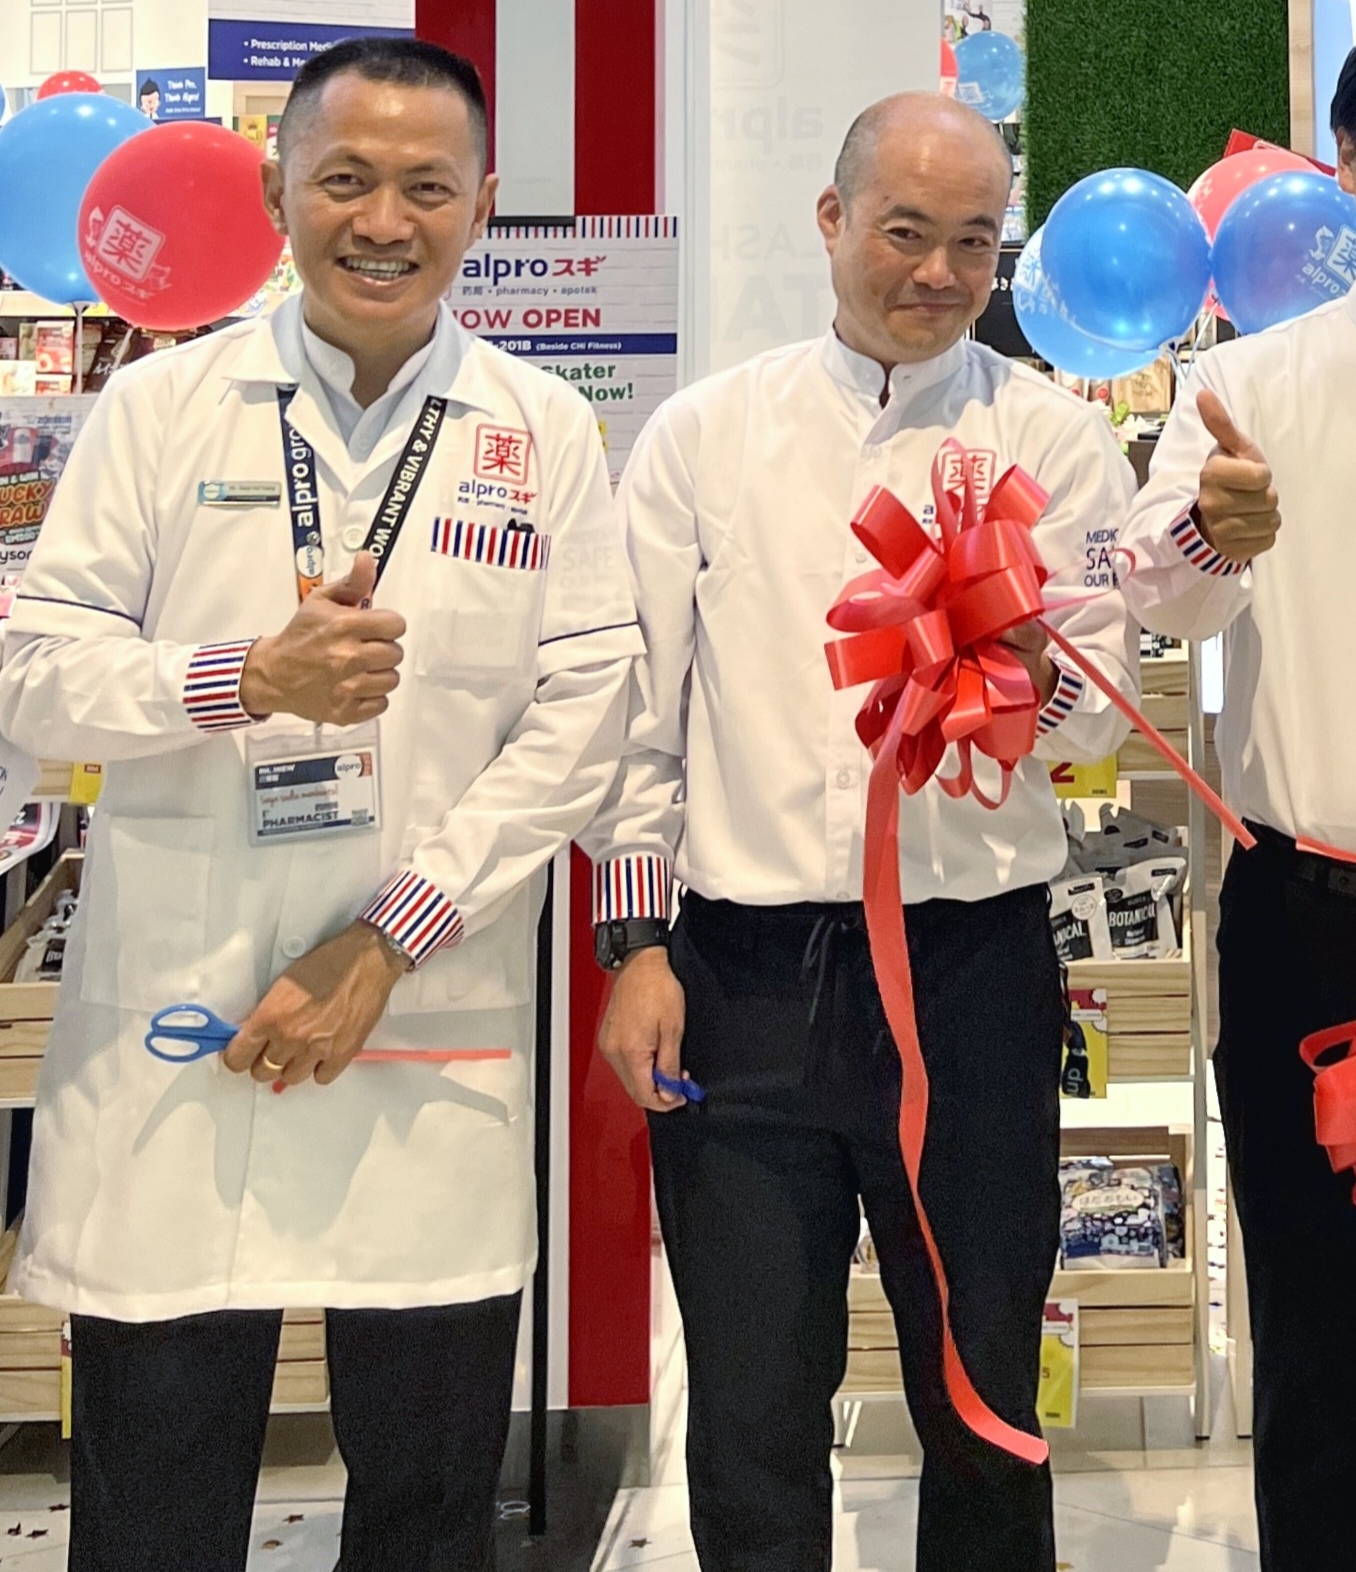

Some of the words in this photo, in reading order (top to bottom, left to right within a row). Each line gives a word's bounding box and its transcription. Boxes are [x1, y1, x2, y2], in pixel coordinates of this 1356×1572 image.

[251, 39, 307, 51] Prescription
[251, 57, 281, 67] Rehab
[283, 57, 290, 67] &
[462, 253, 548, 286] alpro
[552, 255, 607, 277] スギ
[1302, 262, 1341, 294] alpro
[496, 286, 549, 297] pharmacy
[560, 285, 597, 296] apotek
[453, 309, 512, 329] OW
[522, 308, 601, 328] OPEN
[536, 342, 568, 351] (Beside
[587, 341, 622, 351] Fitness)
[578, 382, 633, 402] Now!
[420, 399, 443, 441] LTHY
[289, 425, 312, 460] gro
[411, 439, 428, 453] &
[482, 433, 523, 476] 薬
[0, 479, 56, 505] UCKY
[291, 461, 318, 527] alpro
[381, 454, 423, 531] VIBRANT
[458, 480, 508, 499] alpro
[508, 490, 537, 504] スギ
[0, 501, 47, 526] RAW
[369, 528, 392, 558] WO
[0, 549, 33, 565] yson
[1086, 546, 1112, 570] SA
[1084, 573, 1110, 587] OUR
[262, 810, 339, 828] PHARMACIST
